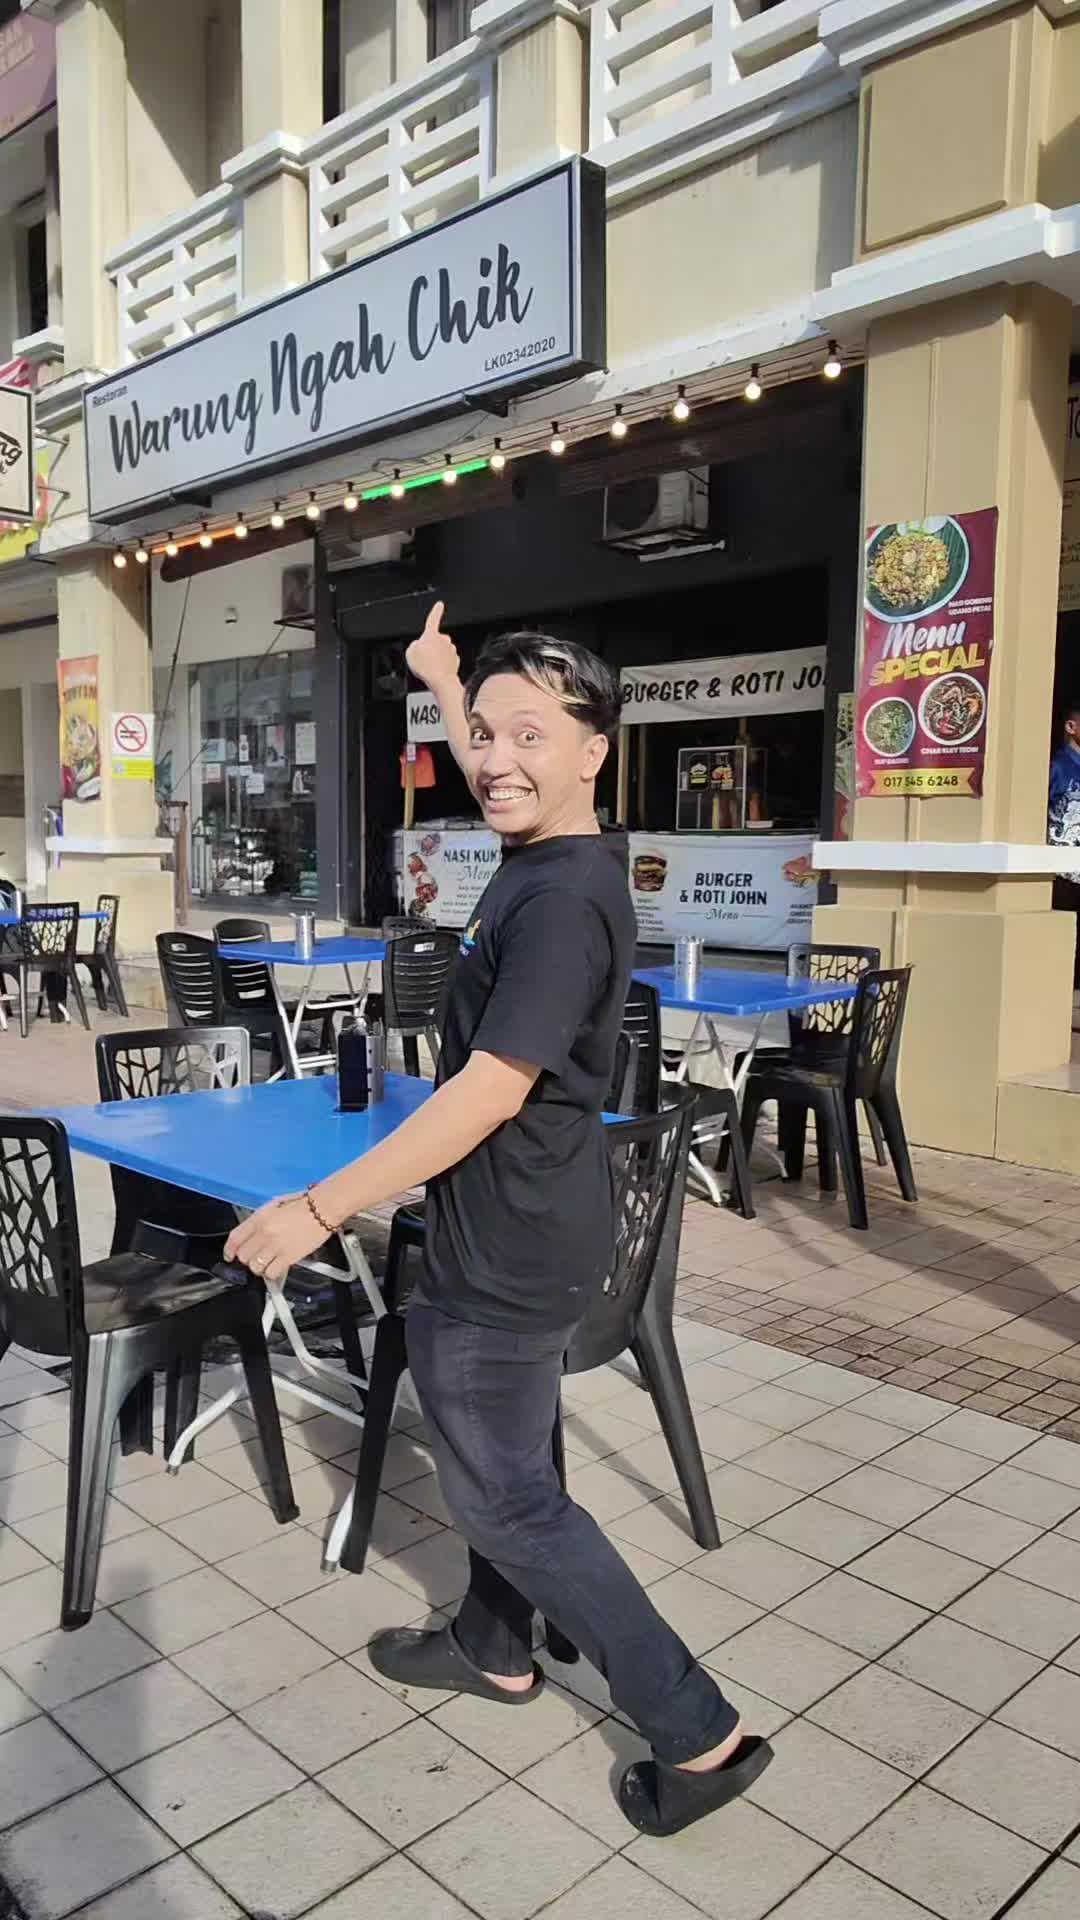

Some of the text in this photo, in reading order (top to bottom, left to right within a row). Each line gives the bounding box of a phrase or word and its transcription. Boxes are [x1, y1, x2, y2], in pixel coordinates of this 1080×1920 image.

[109, 243, 533, 473] Warung Ngah Chik
[484, 336, 556, 372] LK02342020
[881, 621, 966, 660] Menu
[868, 642, 985, 687] SPECIAL
[622, 665, 827, 704] BURGER & ROTI JO
[883, 776, 903, 788] 017
[927, 775, 959, 787] 6248
[444, 849, 500, 863] NASI KUK
[457, 864, 493, 881] Men
[695, 872, 753, 887] BURGER
[679, 889, 768, 905] & ROTI JOHN
[705, 908, 739, 920] Menu
